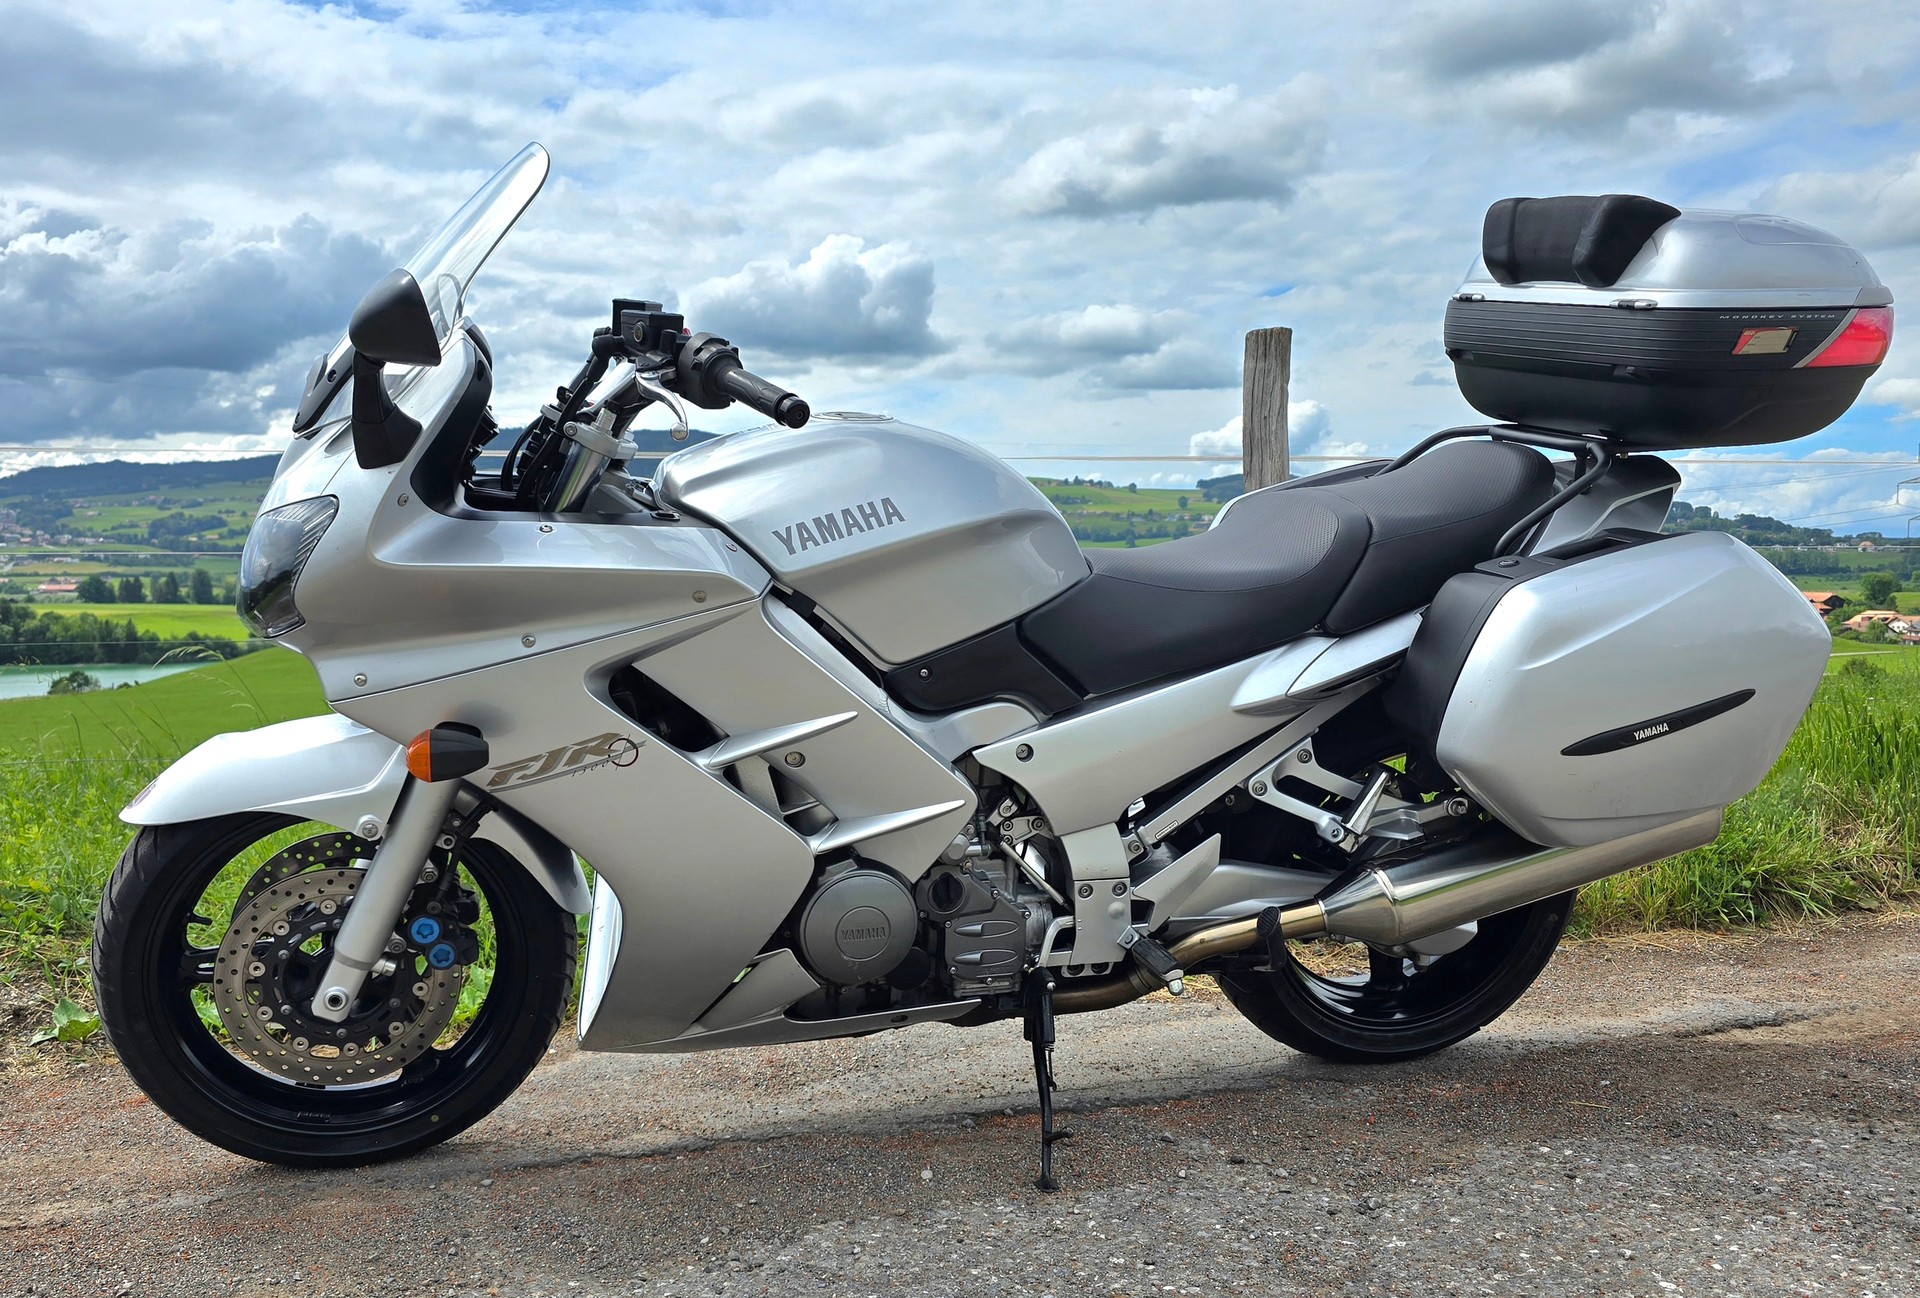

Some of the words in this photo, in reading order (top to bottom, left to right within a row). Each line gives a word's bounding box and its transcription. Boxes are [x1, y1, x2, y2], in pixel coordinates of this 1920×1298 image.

[771, 497, 906, 556] YAMAHA
[1633, 722, 1669, 741] YAMAHA
[486, 732, 624, 787] FJR
[571, 759, 610, 777] 1300
[841, 926, 887, 941] YAMAHA
